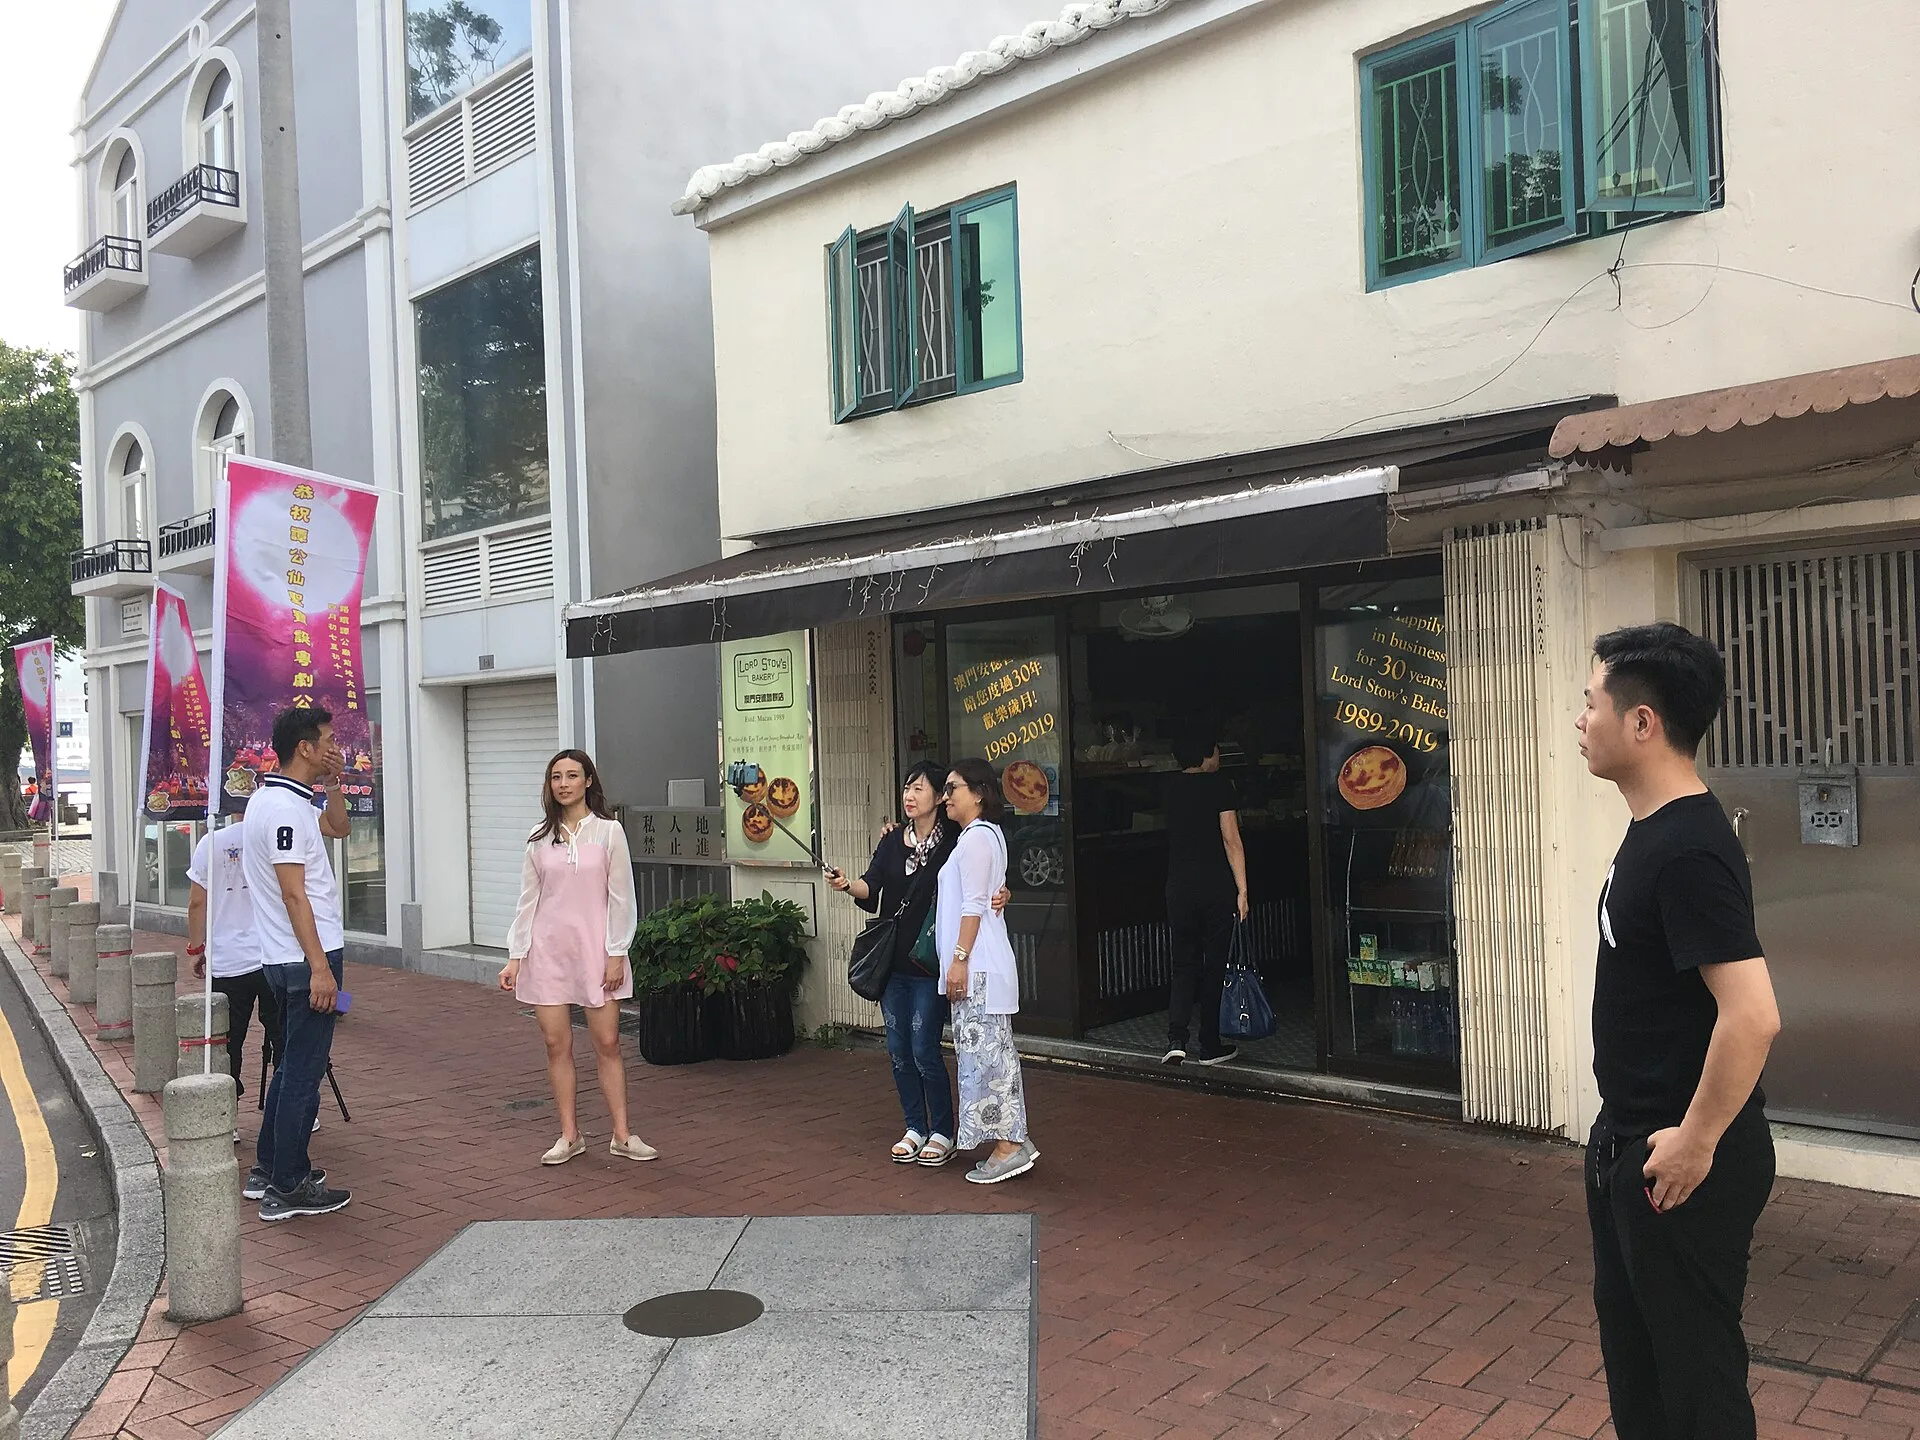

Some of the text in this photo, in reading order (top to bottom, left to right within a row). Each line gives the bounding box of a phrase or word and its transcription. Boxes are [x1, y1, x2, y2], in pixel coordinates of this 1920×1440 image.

[1371, 627, 1447, 663] in business
[752, 673, 775, 682] BAKERY
[1355, 647, 1376, 667] for
[1377, 655, 1406, 681] 30
[1330, 665, 1363, 689] Lord
[1365, 678, 1408, 705] Stow's
[984, 712, 1054, 762] 1989-2019
[1333, 699, 1438, 753] 1989-2019
[276, 826, 294, 851] 8
[643, 815, 710, 835] 私人地
[643, 835, 710, 857] 禁止進
